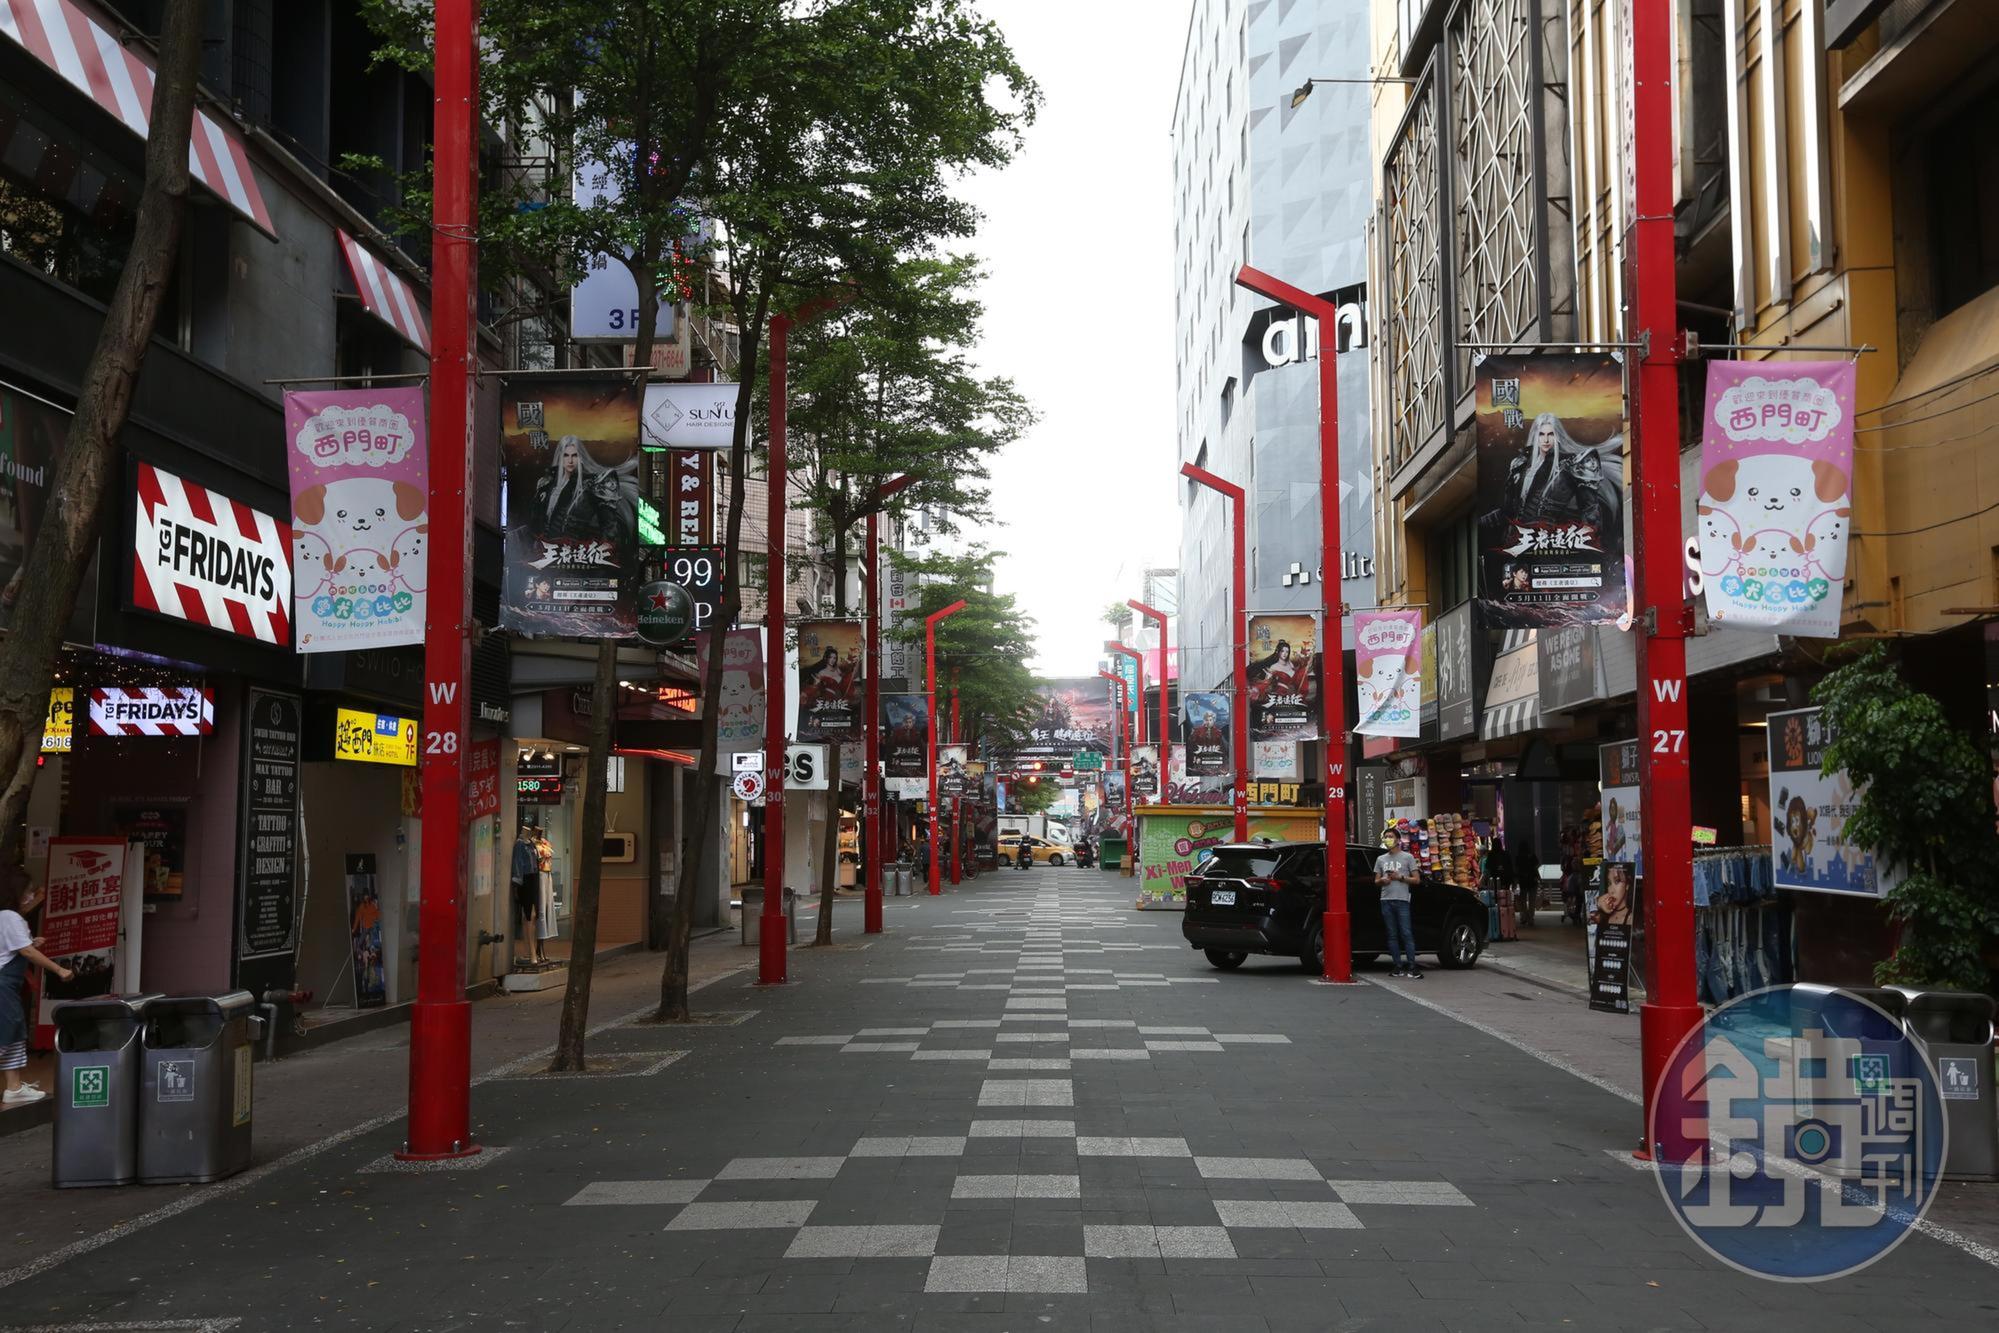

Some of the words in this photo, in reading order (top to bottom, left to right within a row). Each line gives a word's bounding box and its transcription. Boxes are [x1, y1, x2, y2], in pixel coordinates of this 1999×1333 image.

[1491, 377, 1524, 430] 國戰
[517, 401, 550, 451] 國戰
[1730, 403, 1828, 432] 西門町
[314, 429, 403, 458] 西門町
[1503, 524, 1605, 558] 王者遠征
[158, 518, 172, 567] TGI
[173, 523, 275, 602] FRIDAYS
[527, 540, 621, 570] 王者遠征
[674, 557, 713, 587] 99
[1367, 631, 1411, 646] 西門町
[429, 682, 457, 704] W
[1653, 679, 1682, 702] W
[105, 703, 115, 719] TGI
[115, 702, 199, 720] FRIDAYS
[426, 731, 458, 754] 28
[1653, 729, 1686, 753] 27
[406, 743, 415, 760] 7F
[255, 763, 270, 775] MAX
[271, 765, 293, 777] TATTOO
[767, 768, 781, 779] W
[1329, 764, 1344, 775] W
[265, 778, 282, 795] BAR
[517, 780, 541, 791] 1580
[1236, 790, 1246, 798] W
[1246, 782, 1300, 803] 西門町
[1328, 787, 1345, 799] 29
[767, 791, 782, 802] 30
[868, 807, 878, 815] 32
[1236, 806, 1247, 814] 31
[258, 815, 287, 831] TATTOO
[144, 840, 164, 848] OUR
[257, 836, 286, 853] GRAFFITI
[256, 857, 286, 875] DESIGN
[1145, 859, 1193, 881] Xi-Men
[1382, 859, 1403, 872] GAP
[50, 875, 121, 913] 謝師宴
